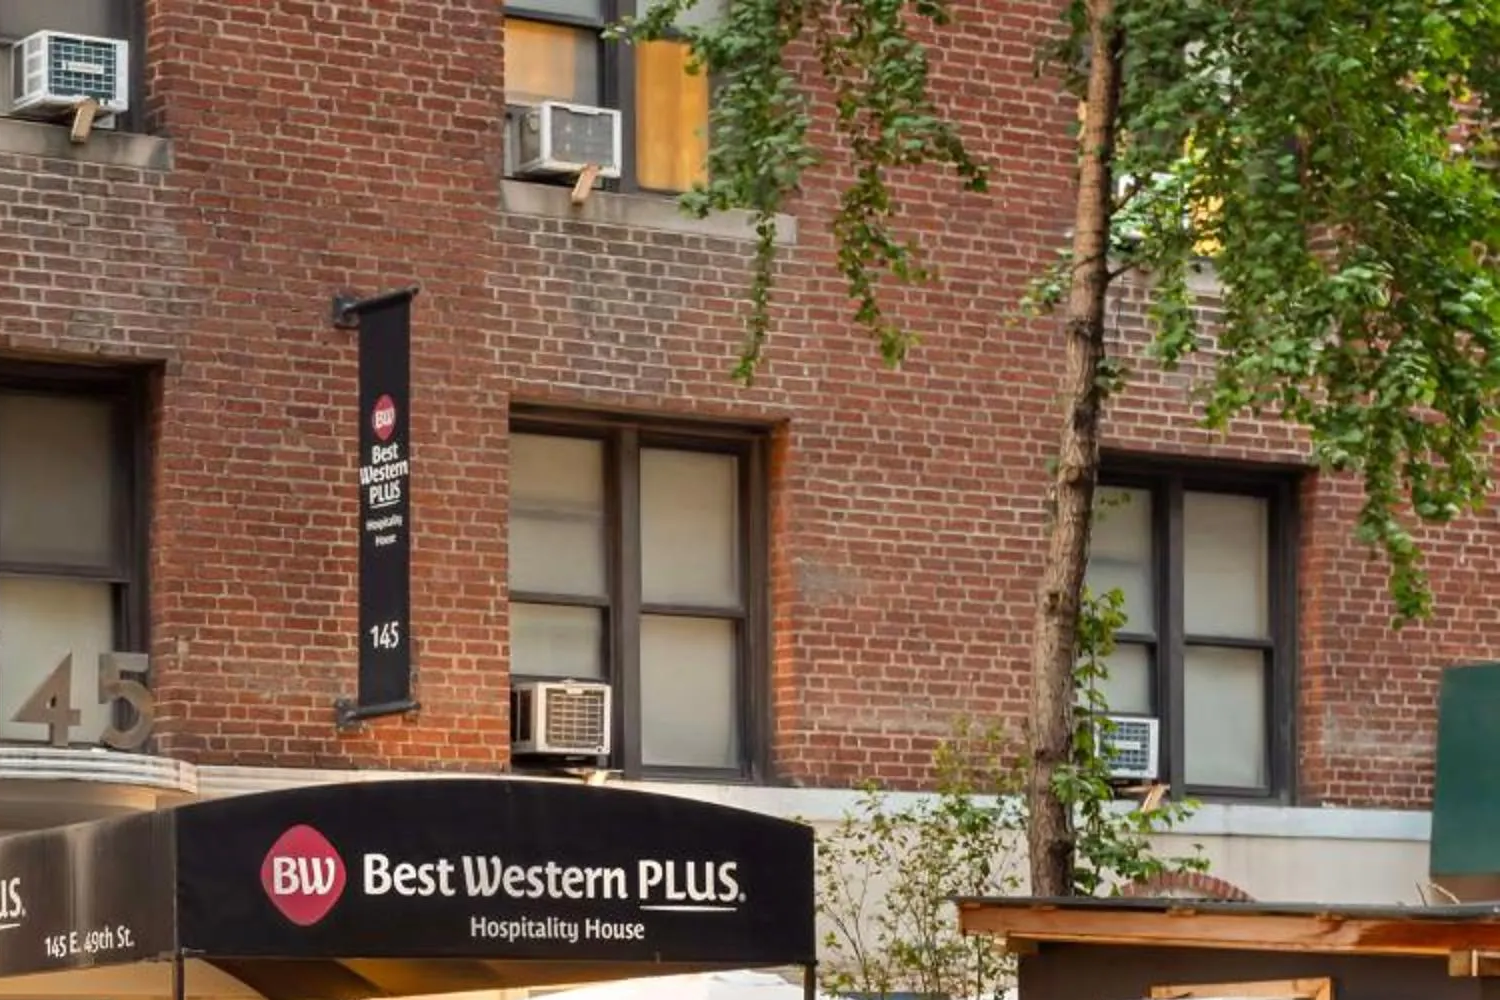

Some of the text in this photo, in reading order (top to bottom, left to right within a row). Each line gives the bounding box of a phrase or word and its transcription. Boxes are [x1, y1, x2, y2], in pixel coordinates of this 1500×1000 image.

[371, 443, 399, 464] Best
[360, 461, 409, 485] Western
[369, 480, 401, 505] PLUS
[370, 621, 400, 649] 145
[273, 857, 337, 895] BW
[363, 853, 456, 896] Best
[462, 856, 628, 898] Western
[45, 925, 135, 958] 145 E. 49th St.
[470, 916, 645, 943] Hospitality House
